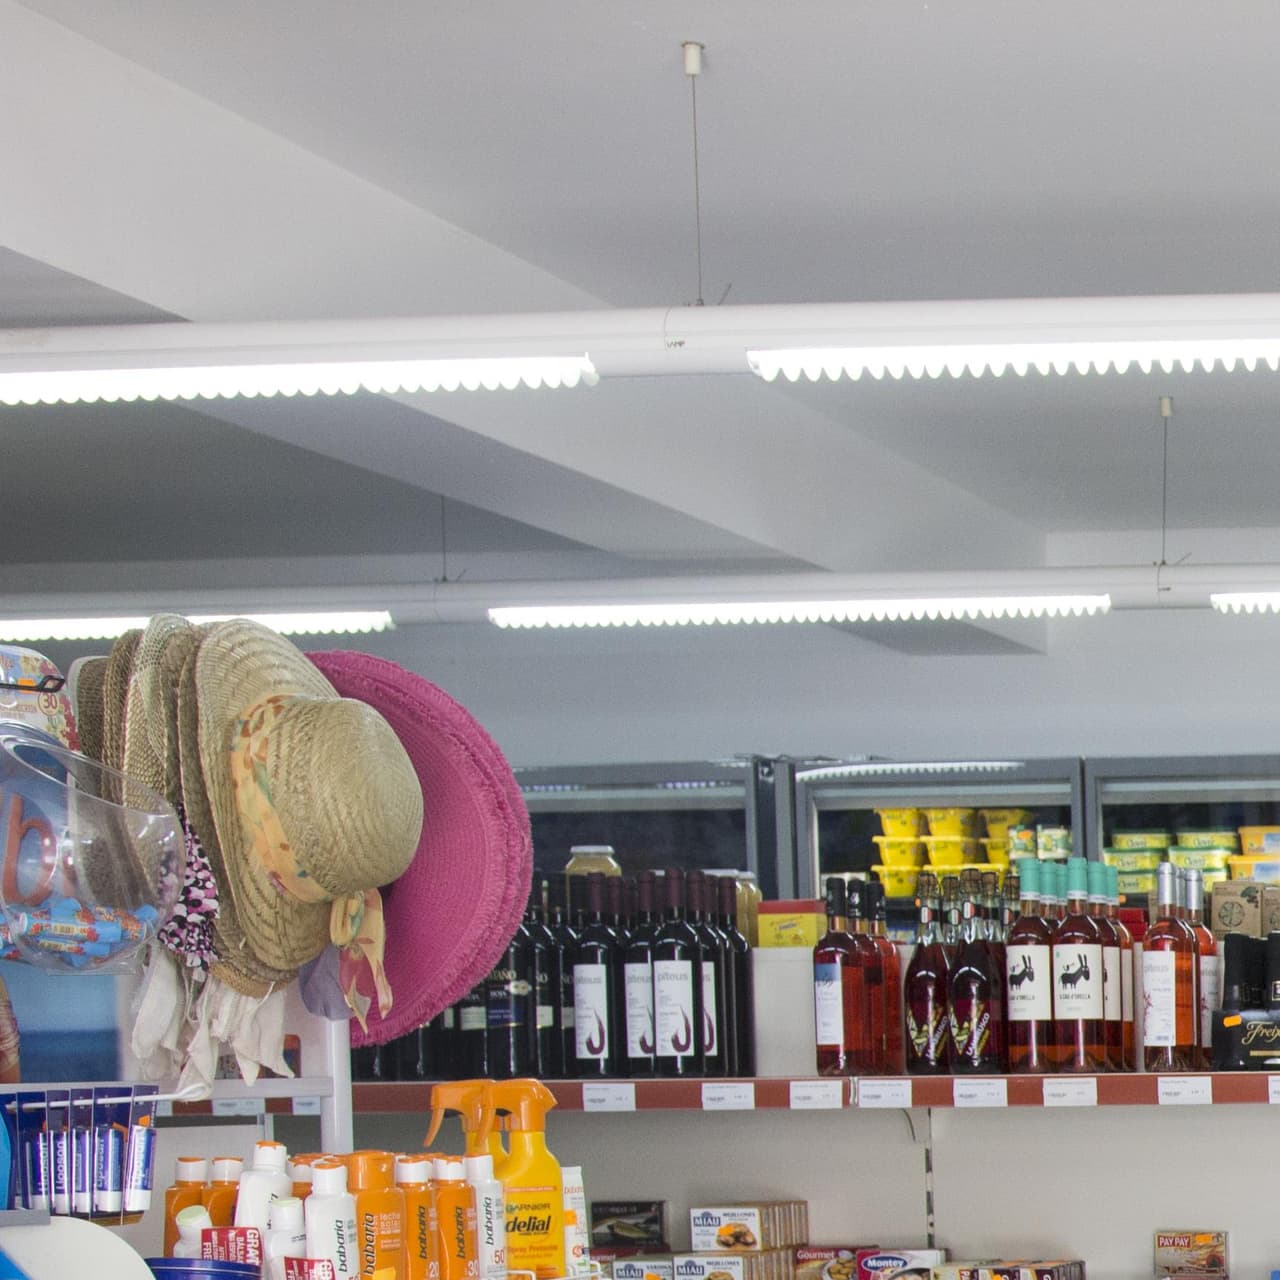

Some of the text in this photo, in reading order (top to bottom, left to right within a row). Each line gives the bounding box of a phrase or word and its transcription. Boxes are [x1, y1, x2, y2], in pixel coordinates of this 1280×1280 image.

[486, 1197, 494, 1246] babaria
[505, 1215, 551, 1233] delial
[694, 1217, 721, 1227] MIAU
[418, 1205, 427, 1260] babaria
[454, 1206, 466, 1260] babaria
[336, 1219, 348, 1273] babaria
[363, 1213, 377, 1276] babaria
[1159, 1237, 1190, 1247] PAY PAY
[796, 1249, 835, 1260] Gourmet
[677, 1264, 704, 1276] MIAU
[866, 1259, 905, 1269] Montey
[616, 1268, 643, 1278] MIAU
